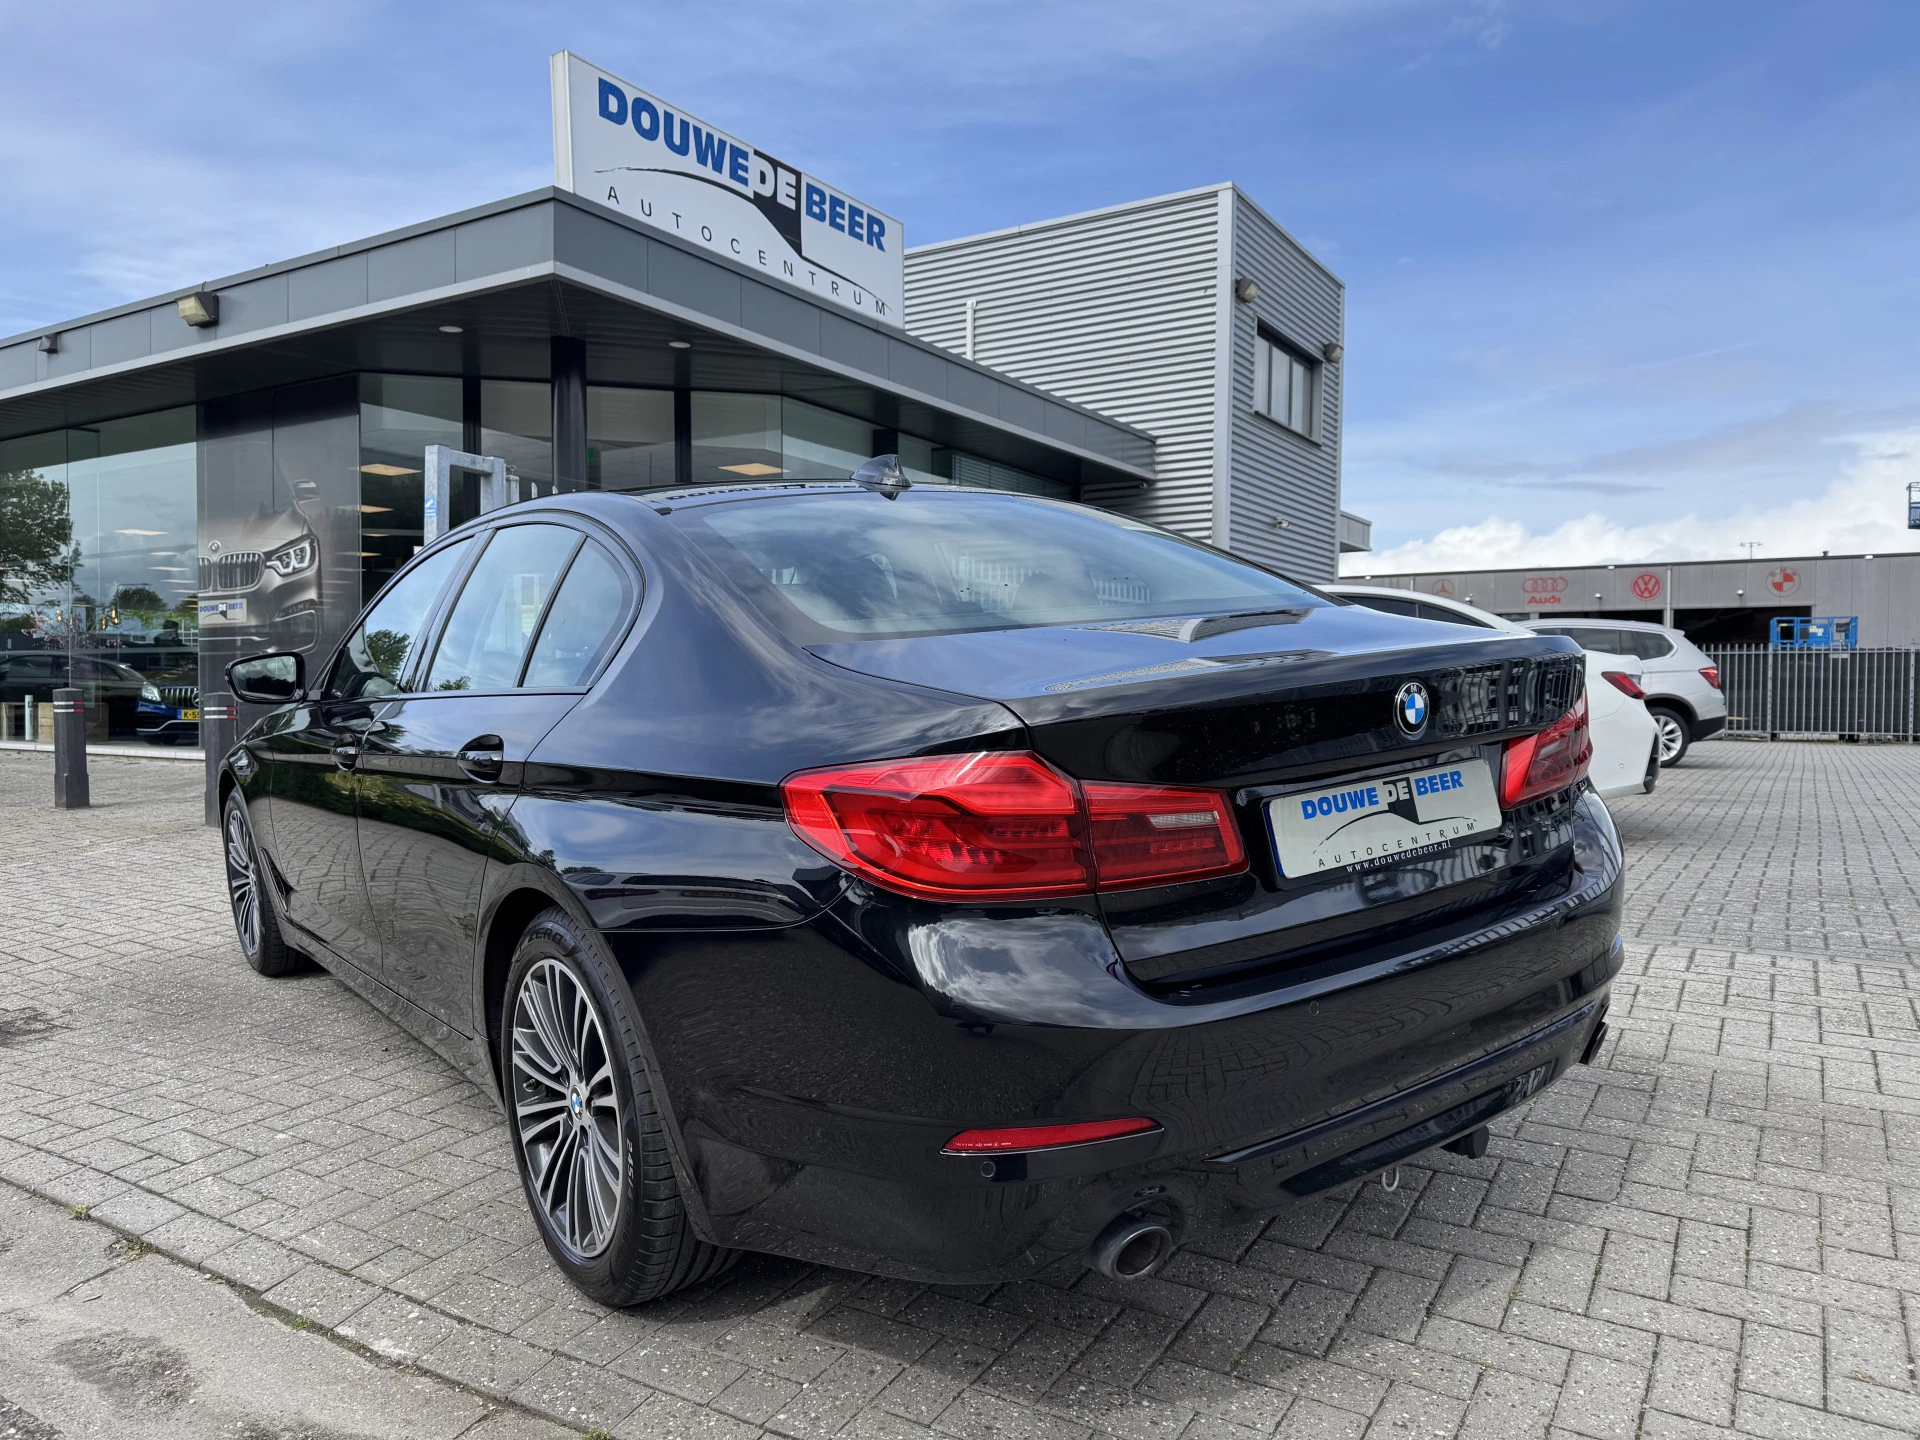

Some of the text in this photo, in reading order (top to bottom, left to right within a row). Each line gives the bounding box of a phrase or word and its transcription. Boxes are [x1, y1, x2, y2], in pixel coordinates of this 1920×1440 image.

[598, 77, 886, 253] DOUWE DE BEER
[607, 186, 886, 316] AUTOCENTRUM
[1527, 594, 1561, 605] Audi
[1401, 684, 1427, 702] BMW
[1301, 770, 1464, 820] DOUWE DE BEER
[1318, 823, 1477, 868] AUTOCENTRUM
[1346, 840, 1452, 873] www.douwedebeer.nl
